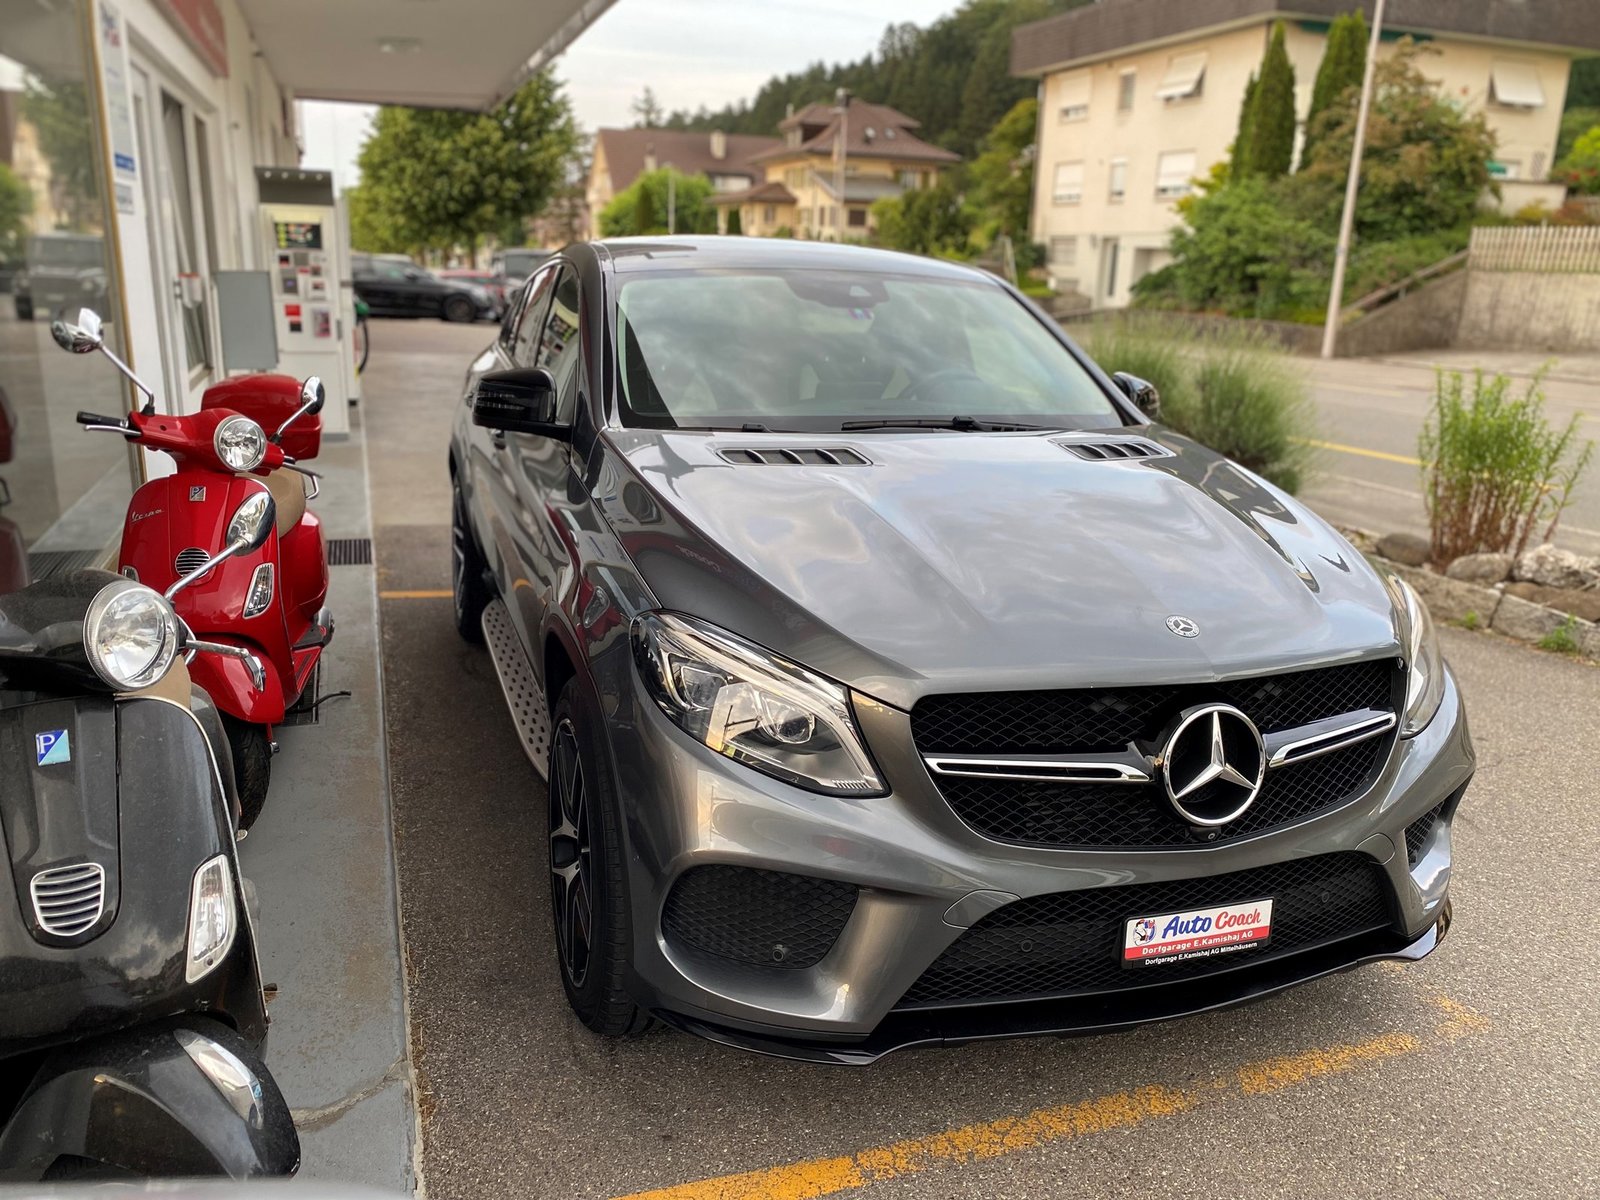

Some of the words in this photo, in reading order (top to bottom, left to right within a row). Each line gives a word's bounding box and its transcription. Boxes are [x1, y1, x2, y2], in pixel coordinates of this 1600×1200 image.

[1161, 915, 1212, 939] Auto
[1215, 908, 1262, 930] Coach
[1142, 942, 1191, 955] Dorfgarage
[1193, 933, 1240, 946] E.Kamishaj
[1241, 930, 1253, 939] AG
[1145, 955, 1178, 965] Dorfgarage
